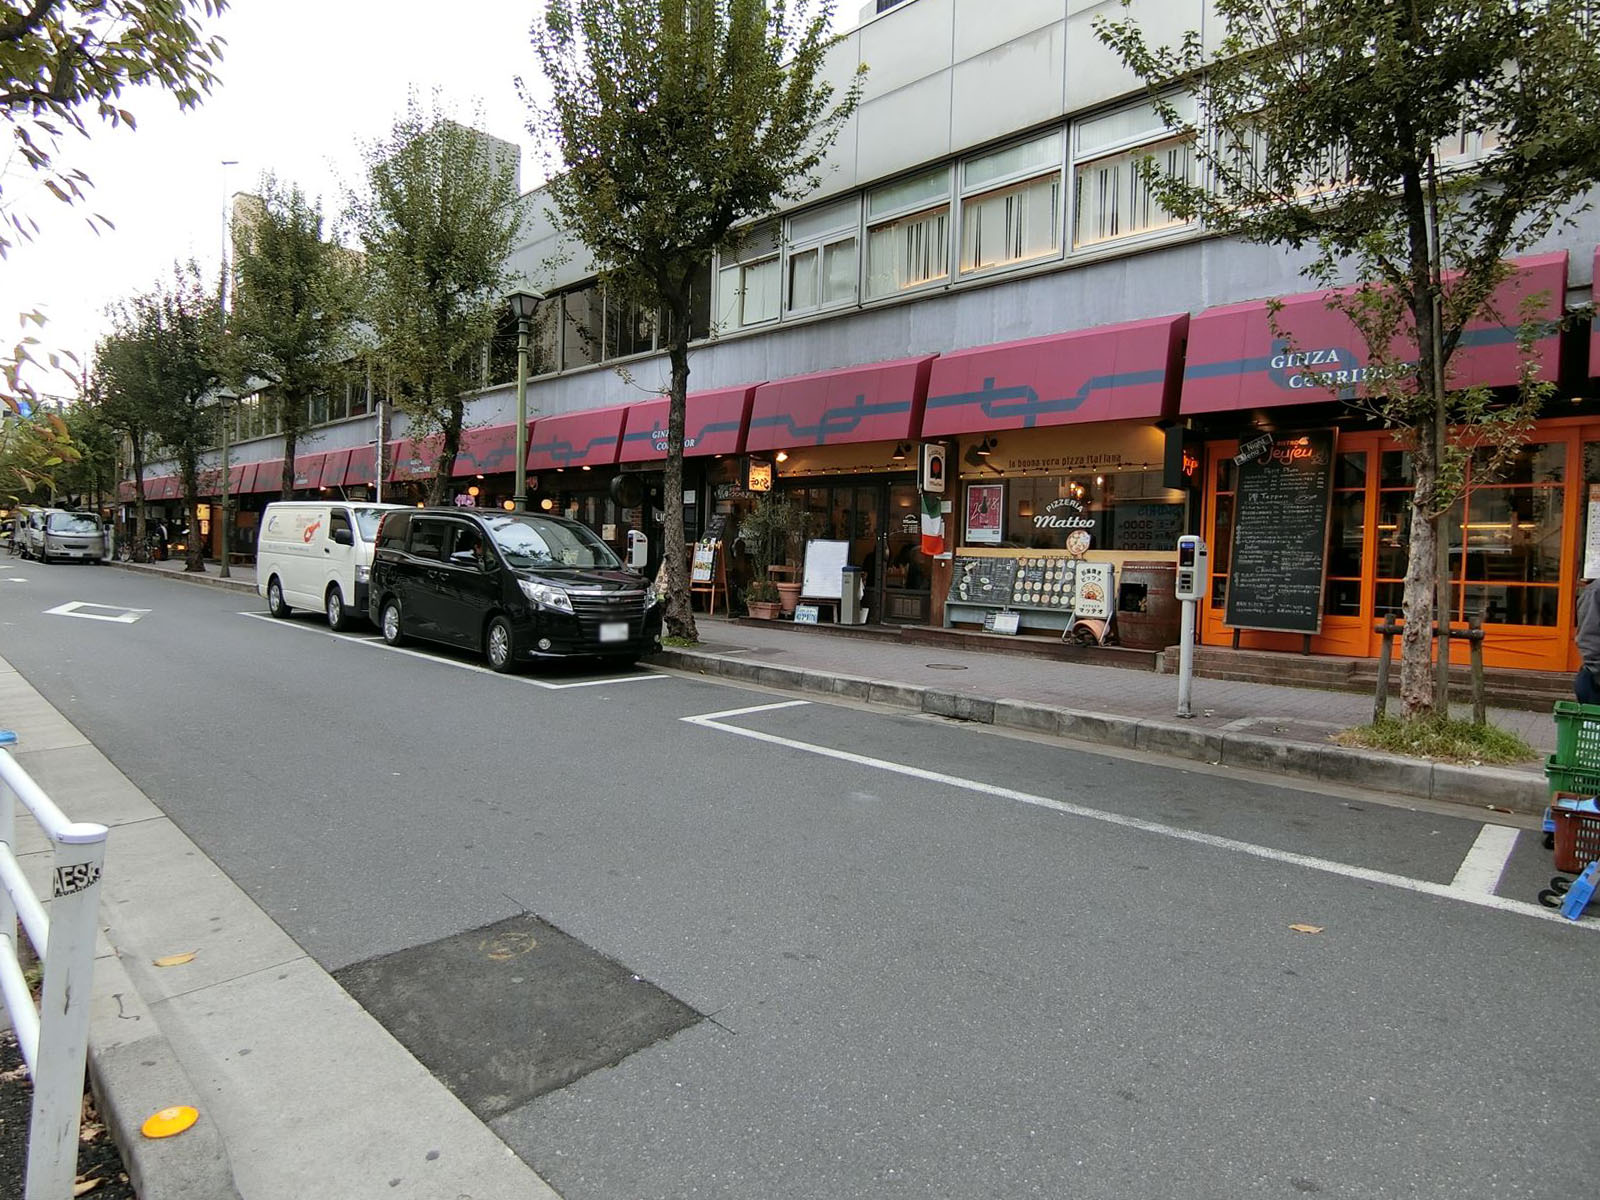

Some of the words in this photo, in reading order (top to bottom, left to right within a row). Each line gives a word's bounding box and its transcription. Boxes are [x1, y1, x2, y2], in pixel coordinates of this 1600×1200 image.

[1271, 349, 1340, 369] GINZA
[1046, 498, 1084, 513] PIZZERIA
[1033, 515, 1096, 528] Matteo
